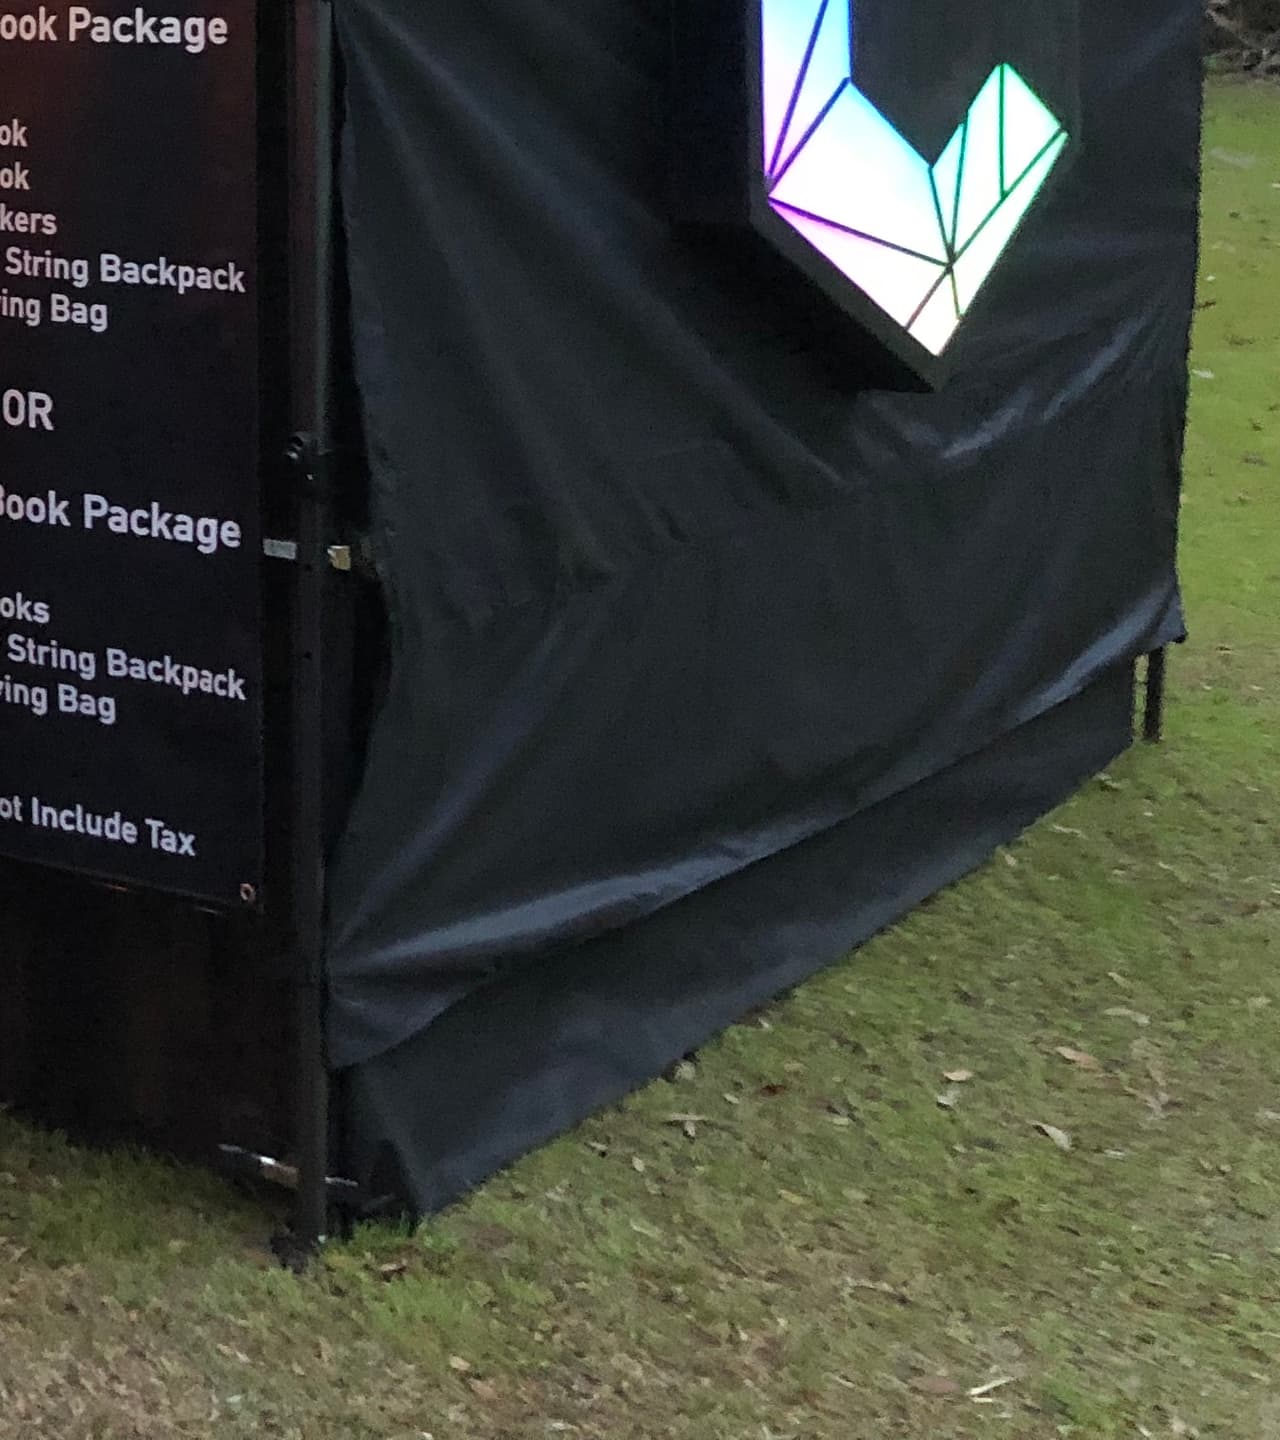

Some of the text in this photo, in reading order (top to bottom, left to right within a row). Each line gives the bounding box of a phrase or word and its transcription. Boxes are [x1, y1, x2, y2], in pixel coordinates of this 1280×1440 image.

[68, 6, 228, 53] Package
[5, 246, 89, 287] String
[100, 253, 245, 294] Backpack
[50, 294, 108, 332] Bag
[2, 389, 54, 431] OR
[83, 494, 241, 554] Package
[7, 633, 95, 681] String
[107, 648, 247, 701] Backpack
[58, 683, 116, 724] Bag
[31, 796, 138, 844] Include
[145, 817, 196, 857] Tax
